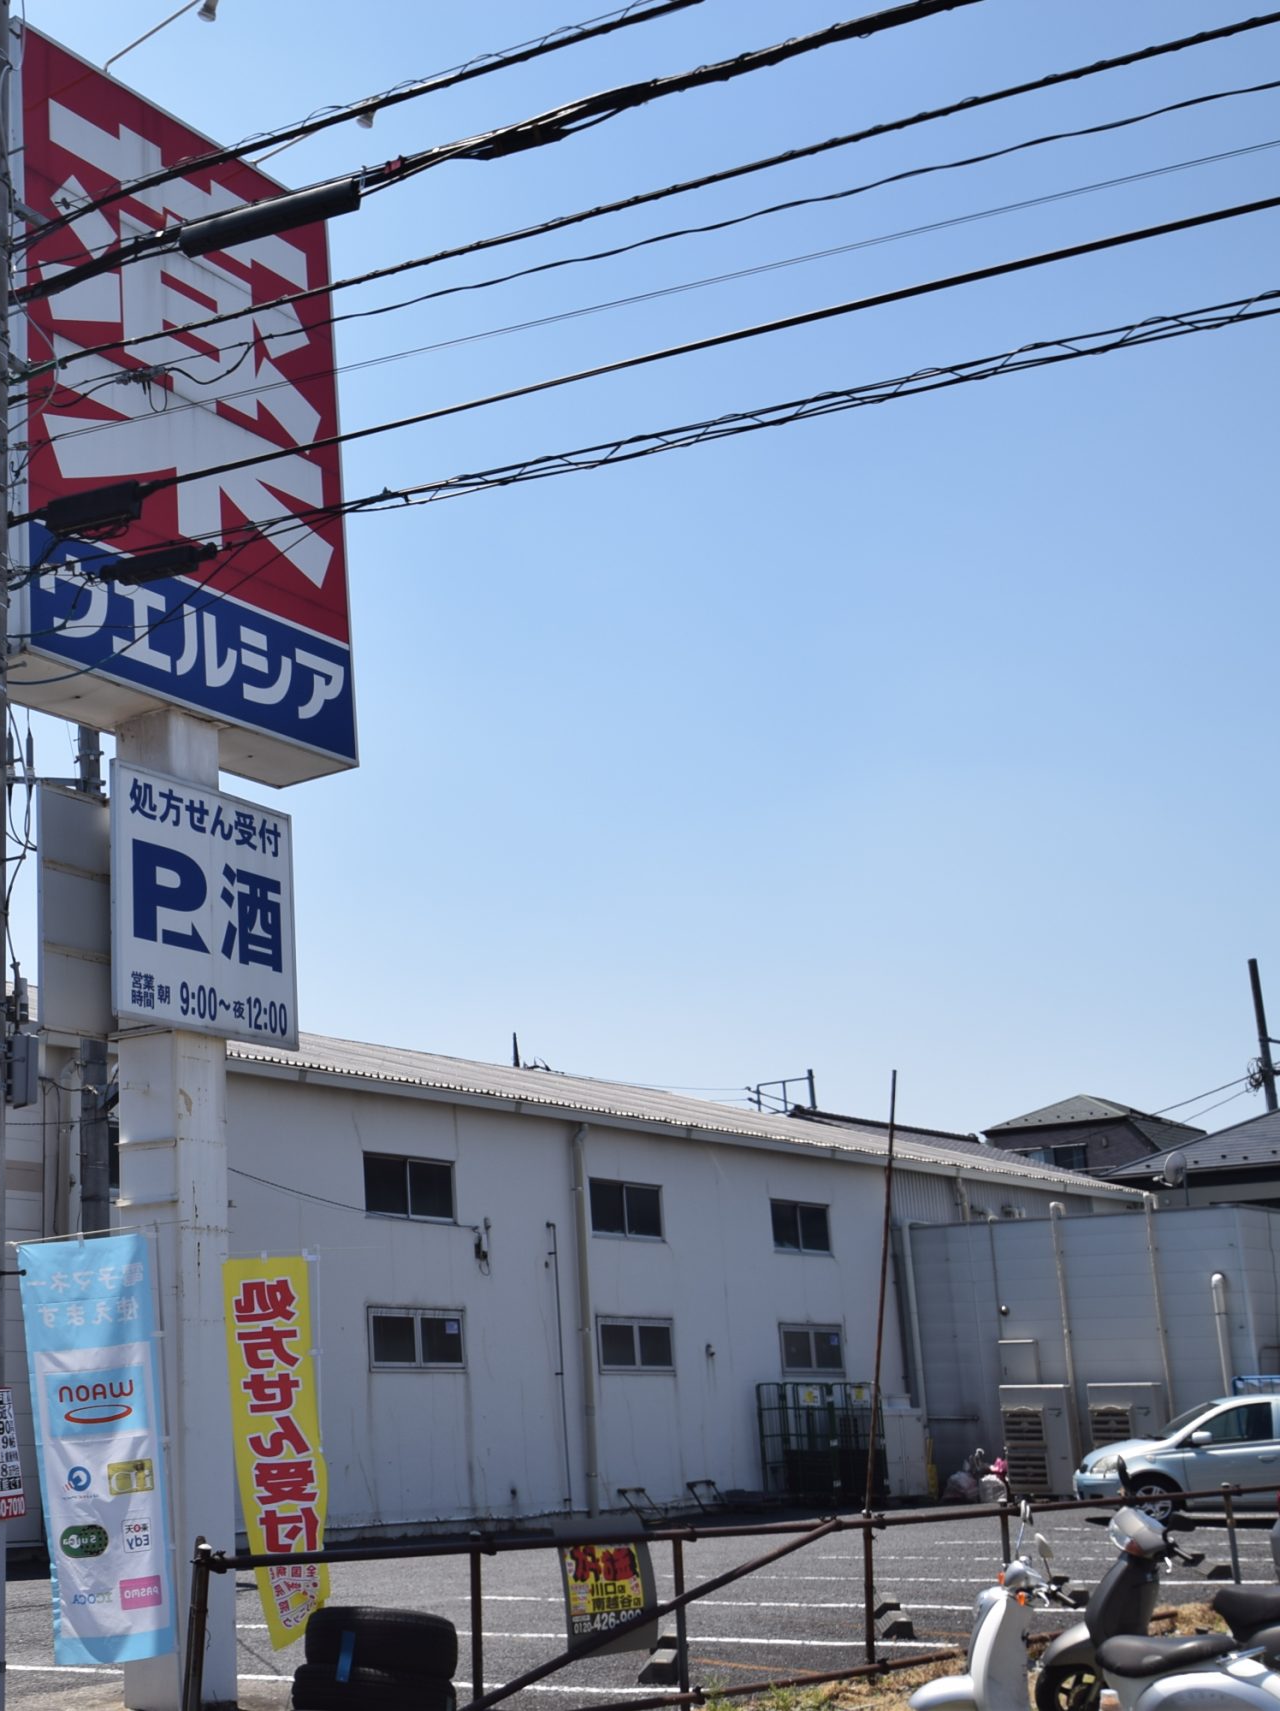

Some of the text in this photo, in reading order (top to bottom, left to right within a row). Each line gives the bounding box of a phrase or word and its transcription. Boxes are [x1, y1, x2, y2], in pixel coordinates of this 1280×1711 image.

[40, 98, 334, 590] 薬
[39, 554, 345, 720] ウエルシア
[129, 777, 282, 858] 処方せん受付
[220, 862, 283, 974] 酒
[131, 970, 155, 992] 営業
[131, 989, 155, 1010] 時間
